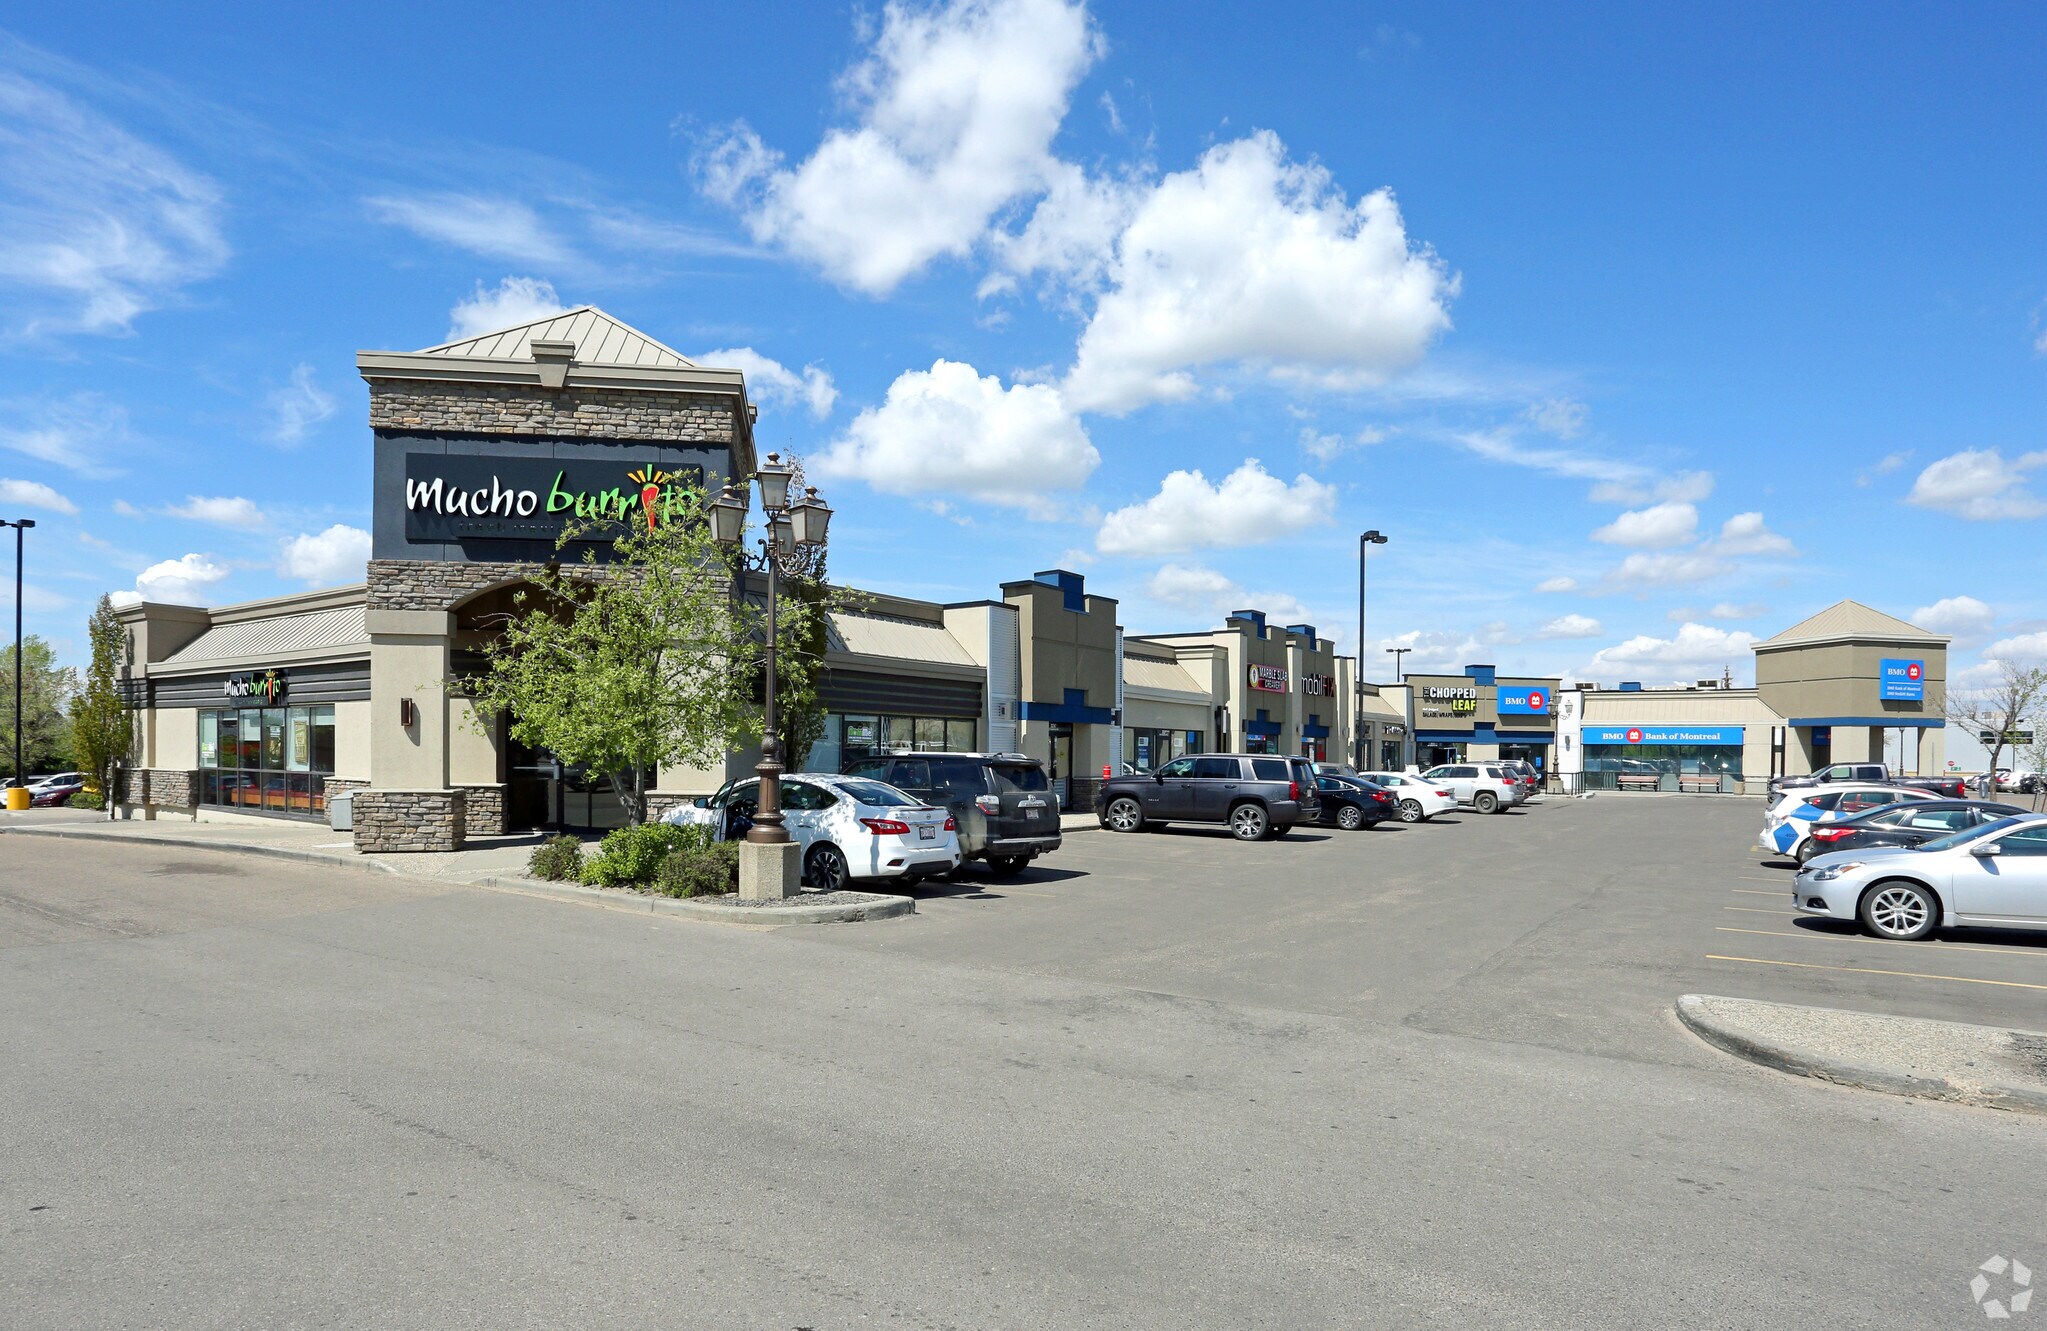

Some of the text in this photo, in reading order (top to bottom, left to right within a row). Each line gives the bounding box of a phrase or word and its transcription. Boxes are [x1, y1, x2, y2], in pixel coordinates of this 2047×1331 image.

[1259, 667, 1288, 682] MARBLE SLAB
[1887, 668, 1906, 676] BMO
[1429, 686, 1476, 699] CHOPPED
[1452, 699, 1476, 711] LEAF
[1505, 697, 1526, 705] BMO
[1645, 732, 1668, 740] Bank
[1668, 732, 1679, 740] of
[1679, 732, 1720, 740] Montreal
